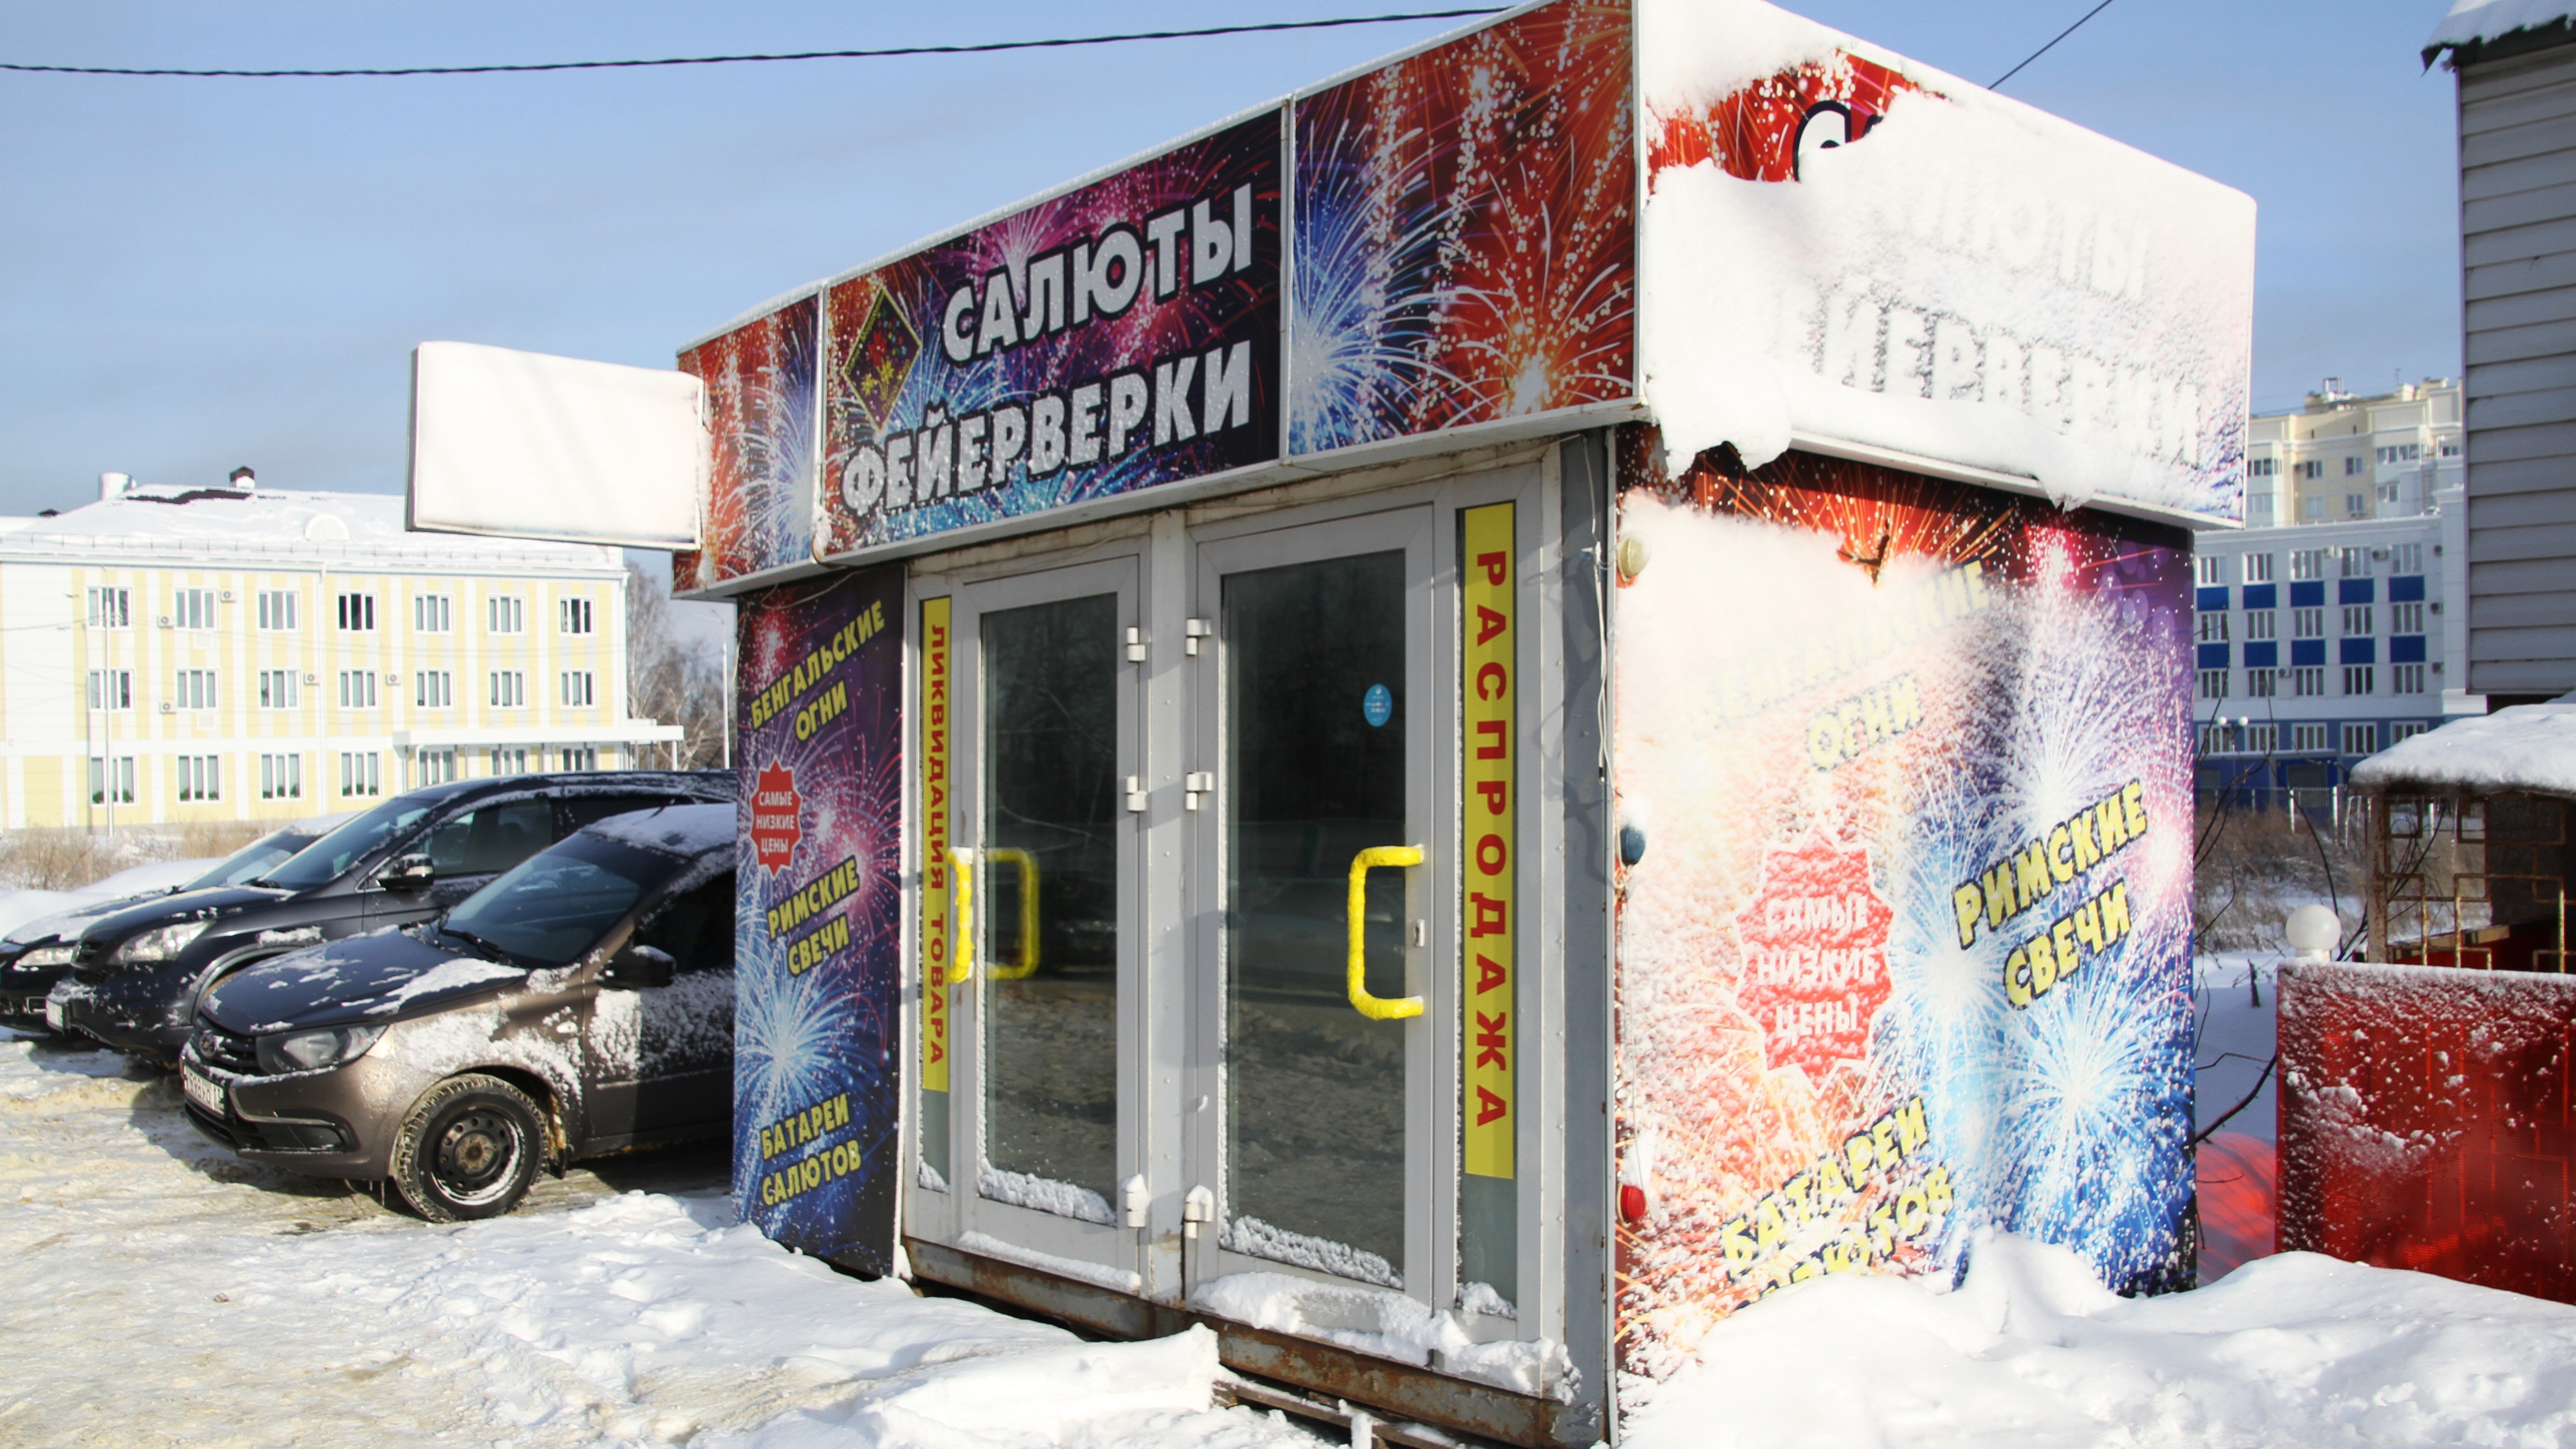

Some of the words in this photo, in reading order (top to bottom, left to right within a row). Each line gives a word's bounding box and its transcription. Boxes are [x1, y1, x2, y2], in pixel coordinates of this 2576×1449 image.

[943, 183, 1252, 362] САЛЮТЫ
[842, 340, 1251, 513] ФЕЙЕРВЕРКИ
[751, 600, 885, 729] БЕНГАЛЬСКИЕ
[796, 681, 847, 741] ОГНИ
[1808, 671, 1921, 770] ОГНИ
[929, 625, 944, 889] ЛИКВИДАЦИЯ
[756, 815, 795, 830] НИЗКИЕ
[758, 791, 793, 806] САМЫЕ
[1469, 550, 1507, 1127] РАСПРОДАЖА
[761, 837, 789, 857] ЦЕНЫ
[1954, 780, 2148, 947] РИМСКИЕ
[768, 858, 859, 939] РИМСКИЕ
[1765, 893, 1868, 931] САМЫЕ
[788, 915, 850, 975] СВЕЧИ
[1756, 947, 1877, 985] НИЗКИЕ
[2004, 882, 2132, 1009] СВЕЧИ
[930, 912, 944, 1064] ТОВАРА
[1775, 1001, 1858, 1046] ЦЕНЫ
[761, 1094, 850, 1160] БАТАРЕИ
[762, 1139, 862, 1207] САЛЮТОВ
[1737, 1165, 1953, 1302] ЮТОВ
